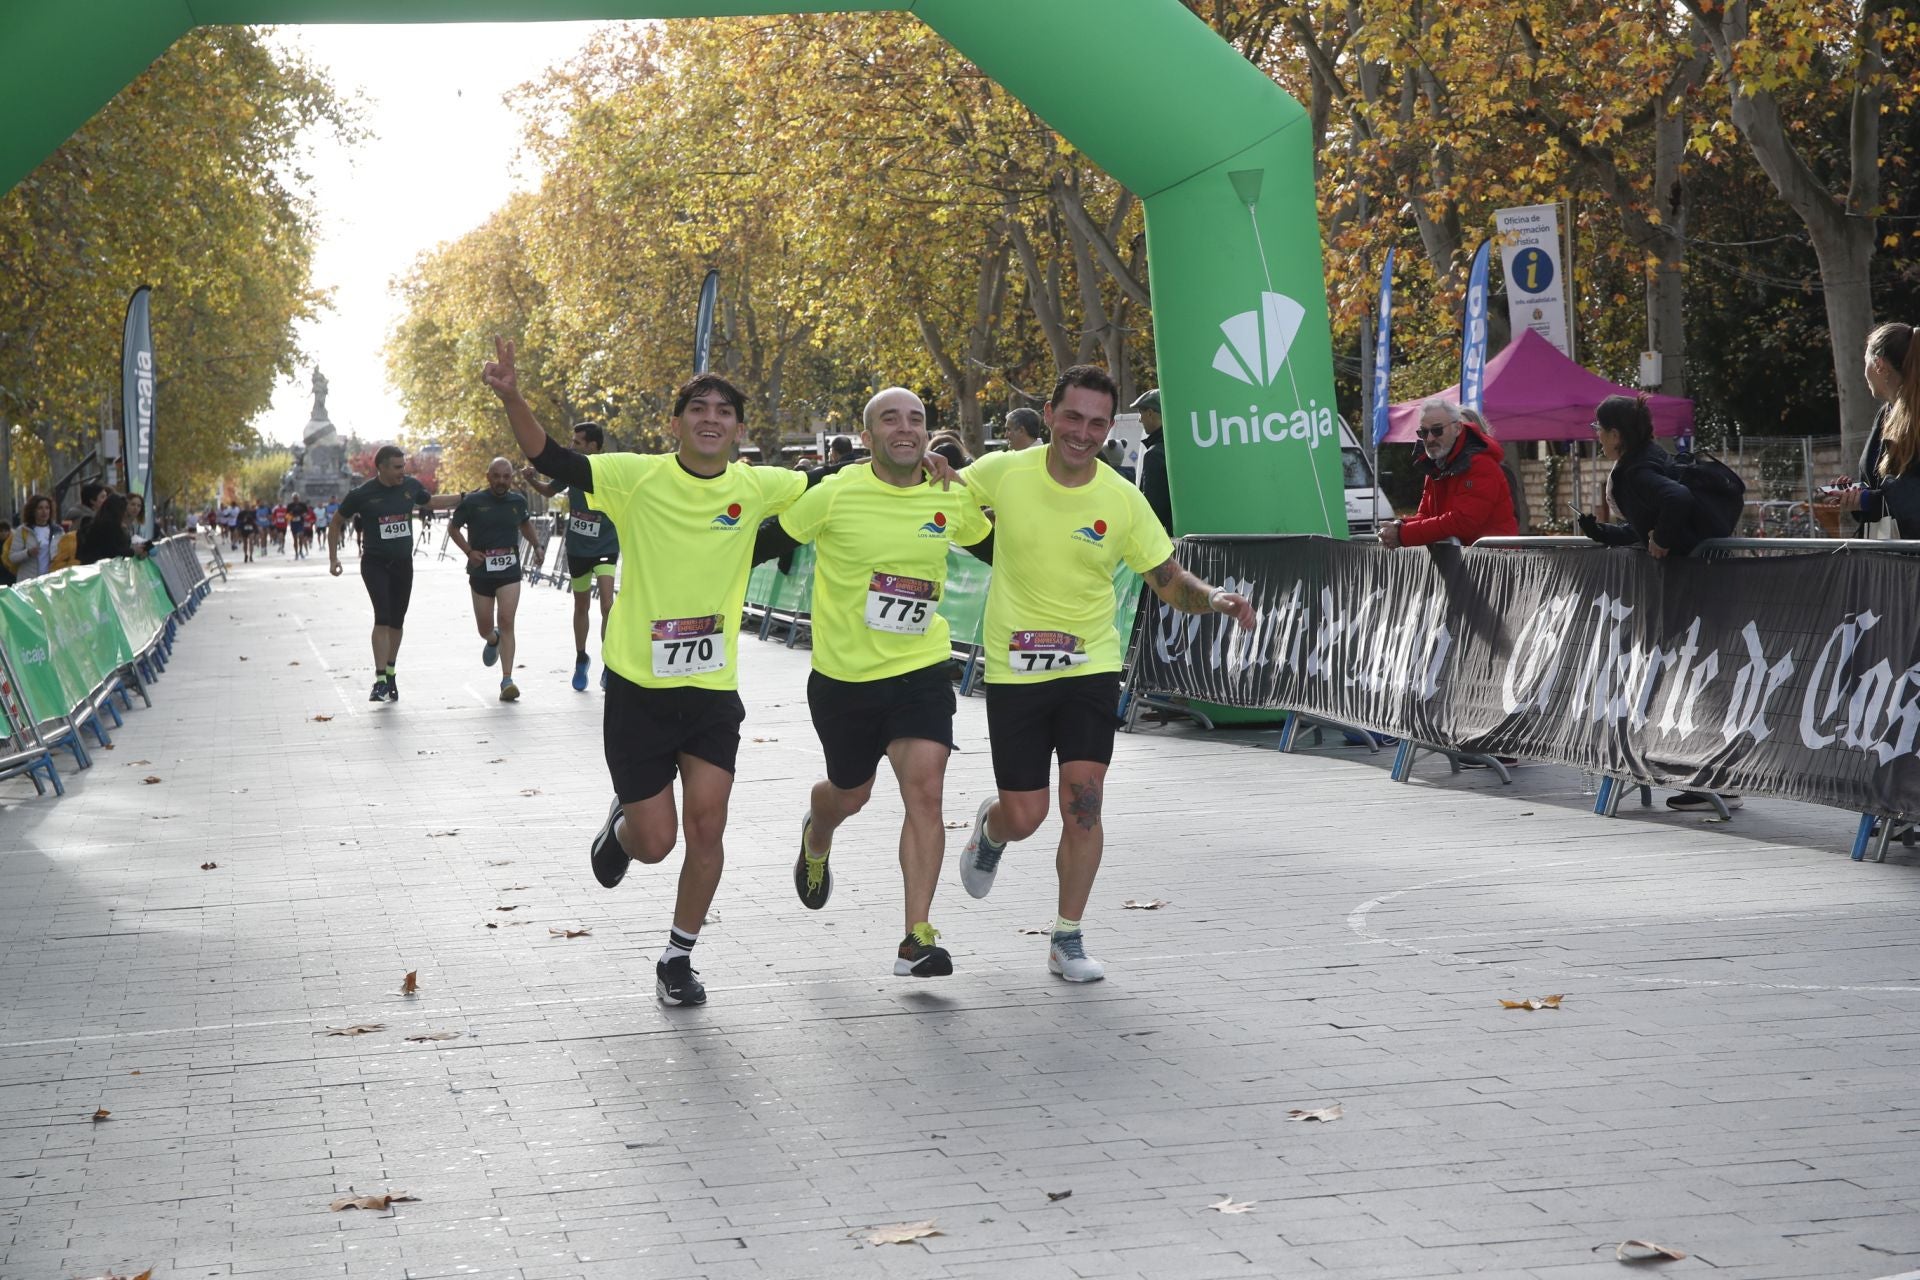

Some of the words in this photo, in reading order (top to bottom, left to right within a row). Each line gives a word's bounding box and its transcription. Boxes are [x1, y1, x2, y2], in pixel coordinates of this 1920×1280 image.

[1504, 216, 1530, 225] Oficina
[1531, 214, 1541, 222] de
[1191, 399, 1333, 449] Unicaja
[385, 522, 407, 534] 490
[574, 520, 594, 532] 491
[490, 556, 512, 567] 492
[879, 595, 928, 624] 775
[663, 638, 713, 665] 770
[1572, 590, 1719, 742] Norte
[1719, 620, 1795, 746] de
[1800, 608, 1920, 768] Cas
